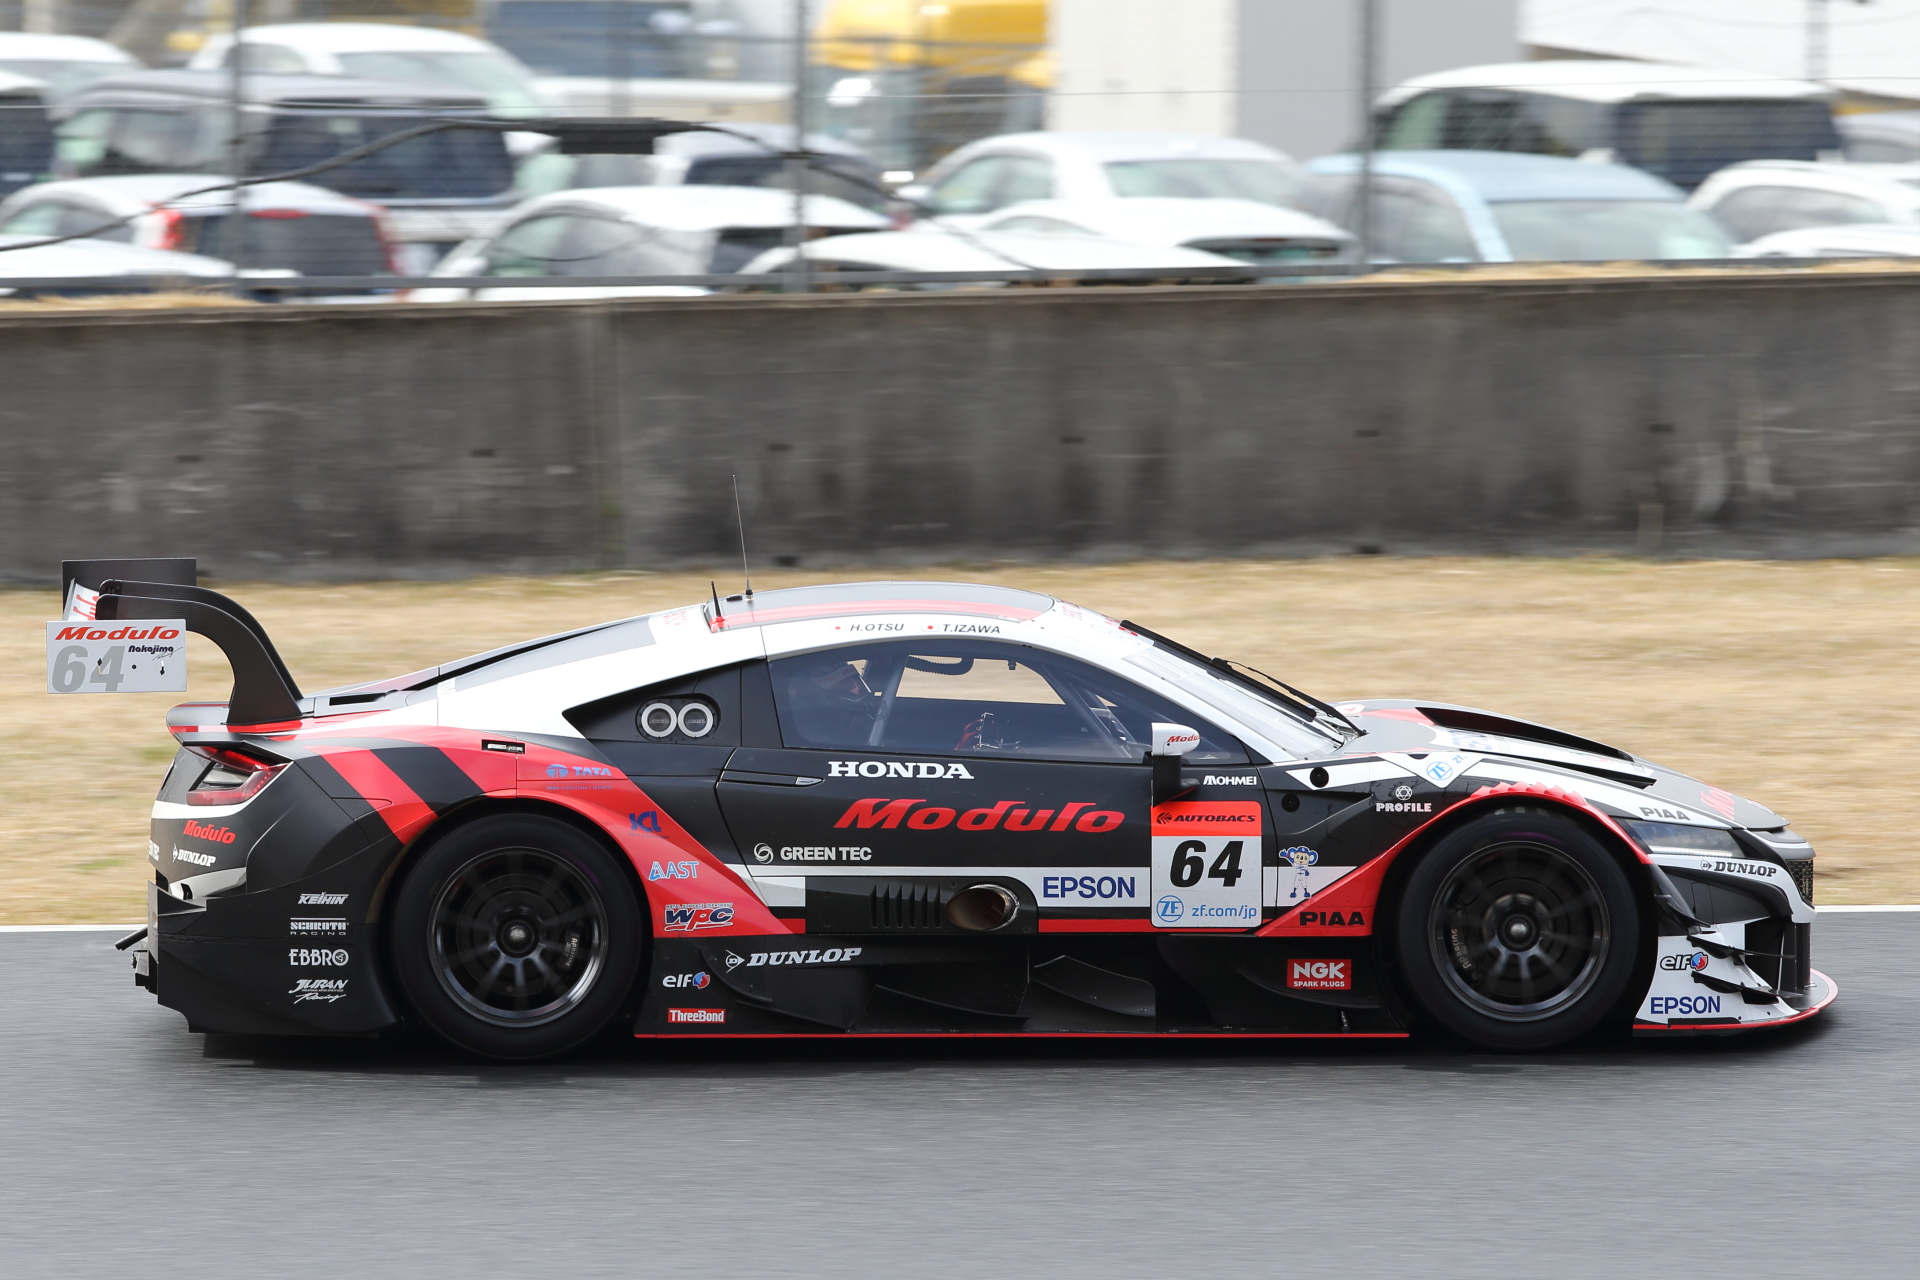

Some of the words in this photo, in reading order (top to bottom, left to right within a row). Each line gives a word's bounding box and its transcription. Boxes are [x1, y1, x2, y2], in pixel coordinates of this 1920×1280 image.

[55, 626, 180, 640] Modulo
[850, 623, 904, 632] H.OTSU
[942, 623, 1000, 634] T.IZAWA
[128, 645, 174, 655] Nakajima
[51, 645, 126, 693] 64
[572, 766, 612, 776] TATA
[827, 760, 974, 780] HONDA
[1376, 802, 1432, 812] PROFILE
[1639, 806, 1691, 821] PIAA
[833, 798, 1125, 832] Modulo
[183, 820, 236, 844] Modulo
[177, 849, 216, 867] DUNLOP
[780, 847, 836, 860] GREEN
[838, 847, 872, 860] TEC
[1170, 840, 1244, 888] 64
[1714, 861, 1777, 877] DUNLOP
[1043, 877, 1135, 898] EPSON
[297, 892, 349, 905] KEIHIN
[1158, 898, 1183, 919] ZF
[1191, 904, 1257, 919] zf.com/jp
[290, 921, 347, 930] SCHROTH
[1300, 911, 1365, 926] PIAA
[288, 948, 349, 967] EBBRO
[746, 947, 862, 967] DUNLOP
[1660, 953, 1693, 971] elf
[1293, 962, 1345, 979] NGK
[288, 979, 349, 994] JURAN
[662, 974, 693, 988] elf
[1650, 995, 1721, 1014] EPSON
[669, 1009, 725, 1022] ThreeBond
